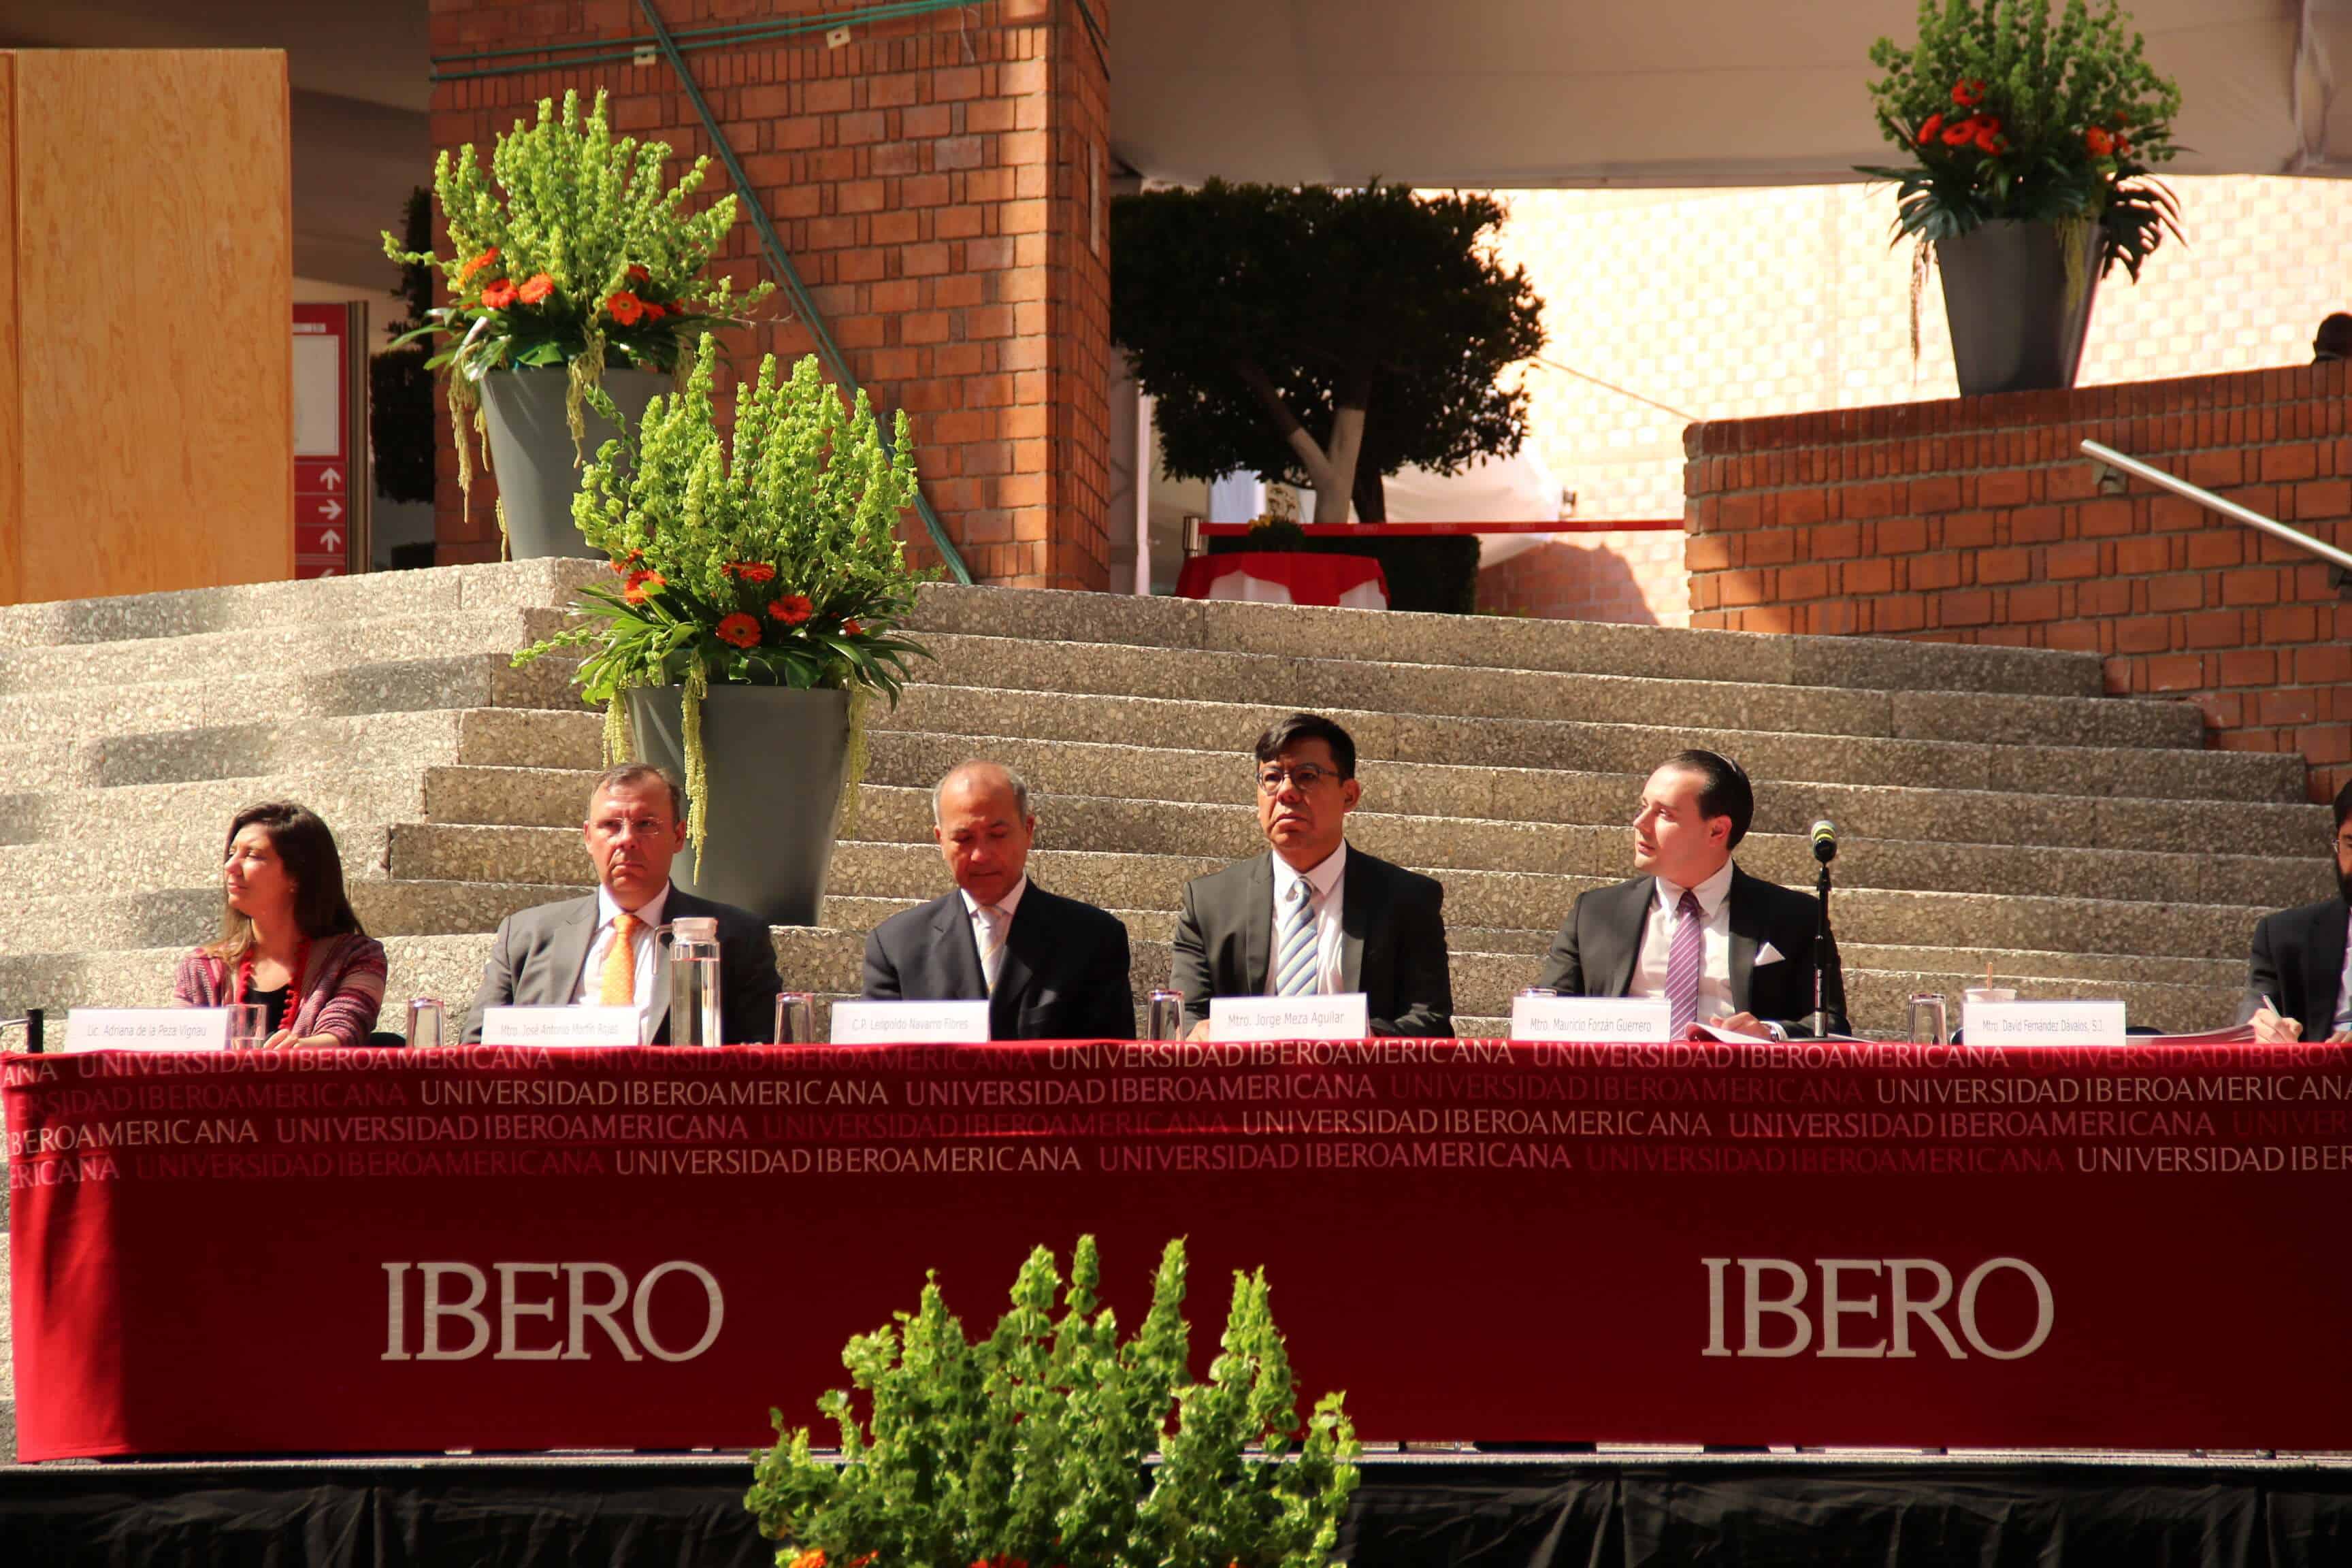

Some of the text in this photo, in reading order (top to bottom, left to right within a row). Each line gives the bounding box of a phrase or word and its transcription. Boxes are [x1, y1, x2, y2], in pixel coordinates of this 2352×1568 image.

[103, 1023, 134, 1036] Adriana
[136, 1023, 146, 1036] de
[149, 1023, 156, 1036] la
[179, 1023, 207, 1039] Vignau
[1228, 1010, 1345, 1028] Mtro. Jorge Meza Aguilar
[1553, 1017, 1586, 1031] Mauricio
[1616, 1018, 1652, 1032] Guerrero
[2002, 1018, 2023, 1032] David
[76, 1049, 282, 1079] UNIVERSIDAD
[289, 1045, 555, 1073] IBEROAMERICANA
[571, 1046, 764, 1072] UNIVERSIDAD
[774, 1045, 1035, 1071] IBEROAMERICANA
[1049, 1043, 1245, 1071] UNIVERSIDAD
[1250, 1039, 1514, 1066] IBEROAMERICANA
[1533, 1043, 1733, 1068] UNIVERSIDAD
[1740, 1043, 2010, 1069] IBEROAMERICANA
[2027, 1045, 2232, 1069] UNIVERSIDAD
[138, 1082, 408, 1112] IBEROAMERICANA
[420, 1079, 618, 1107] UNIVERSIDAD
[623, 1079, 889, 1106] IBEROAMERICANA
[906, 1079, 1106, 1107] UNIVERSIDAD
[1111, 1073, 1377, 1103] IBEROAMERICANA
[1390, 1073, 1588, 1101] UNIVERSIDAD
[1594, 1077, 1864, 1104] IBEROAMERICANA
[1876, 1077, 2079, 1105] UNIVERSIDAD
[276, 1113, 479, 1145] UNIVERSIDAD
[484, 1113, 748, 1141] IBEROAMERICANA
[762, 1113, 957, 1140] UNIVERSIDAD
[964, 1110, 1226, 1138] IBEROAMERICANA
[1241, 1109, 1438, 1136] UNIVERSIDAD
[1445, 1109, 1712, 1137] IBEROAMERICANA
[1729, 1111, 1933, 1139] UNIVERSIDAD
[1940, 1110, 2216, 1137] IBEROAMERICANA
[137, 1152, 332, 1179] UNIVERSIDAD
[340, 1150, 604, 1179] IBEROAMERICANA
[615, 1147, 811, 1175] UNIVERSIDAD
[816, 1145, 1083, 1173] IBEROAMERICANA
[1099, 1143, 1300, 1171] UNIVERSIDAD
[1305, 1141, 1573, 1170] IBEROAMERICANA
[1584, 1143, 1786, 1173] UNIVERSIDAD
[1791, 1145, 2065, 1173] IBEROAMERICANA
[2077, 1145, 2285, 1173] UNIVERSIDAD
[380, 1260, 724, 1362] IBERO
[1701, 1257, 2054, 1360] IBERO
